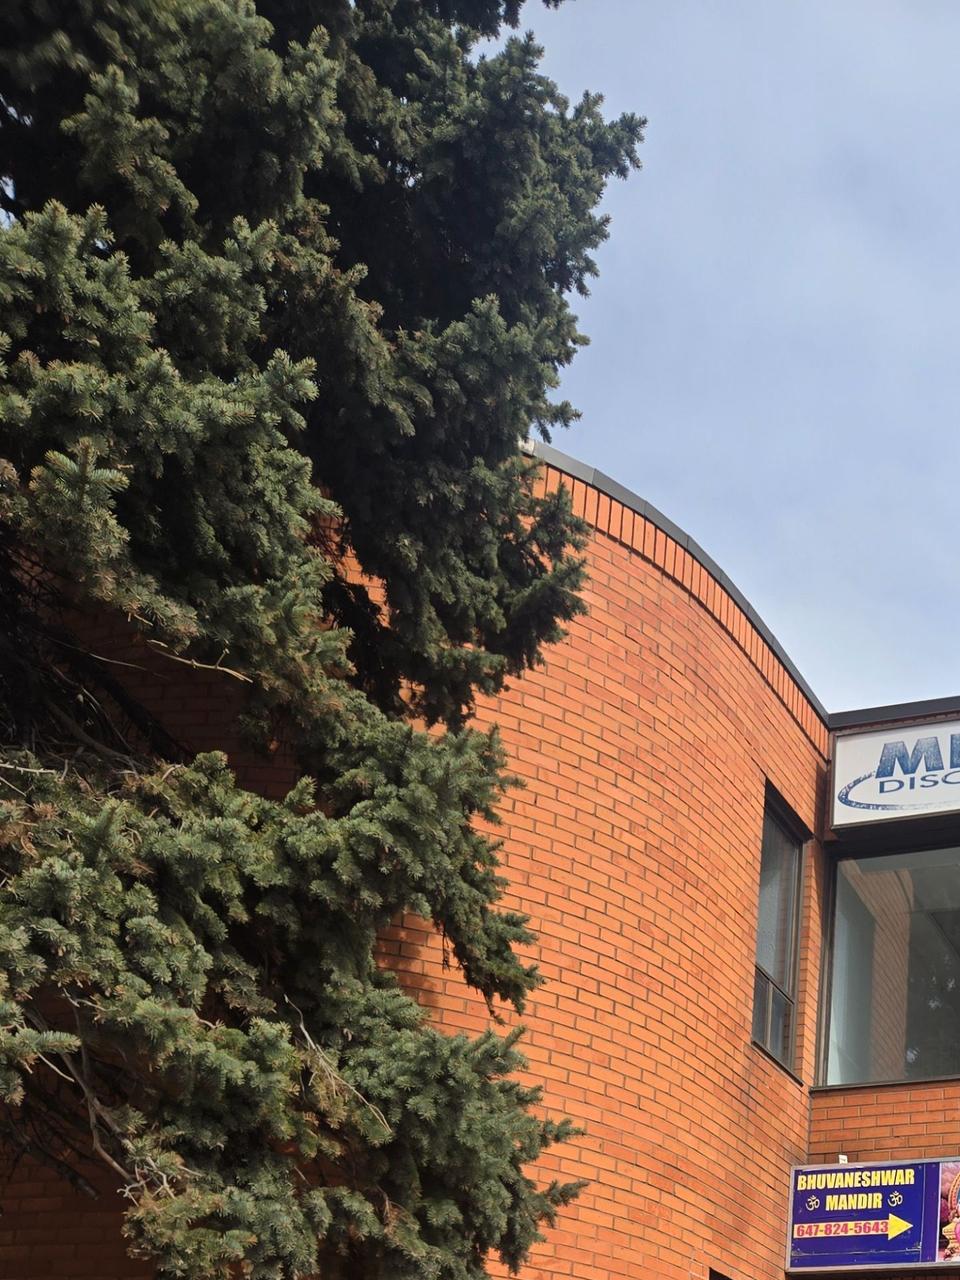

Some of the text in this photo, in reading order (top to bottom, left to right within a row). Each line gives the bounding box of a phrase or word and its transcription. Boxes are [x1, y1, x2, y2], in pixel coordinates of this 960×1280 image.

[797, 1168, 915, 1191] BHUVANESHWAR
[825, 1192, 883, 1211] MANDIR
[796, 1221, 888, 1237] 647-824-5643
